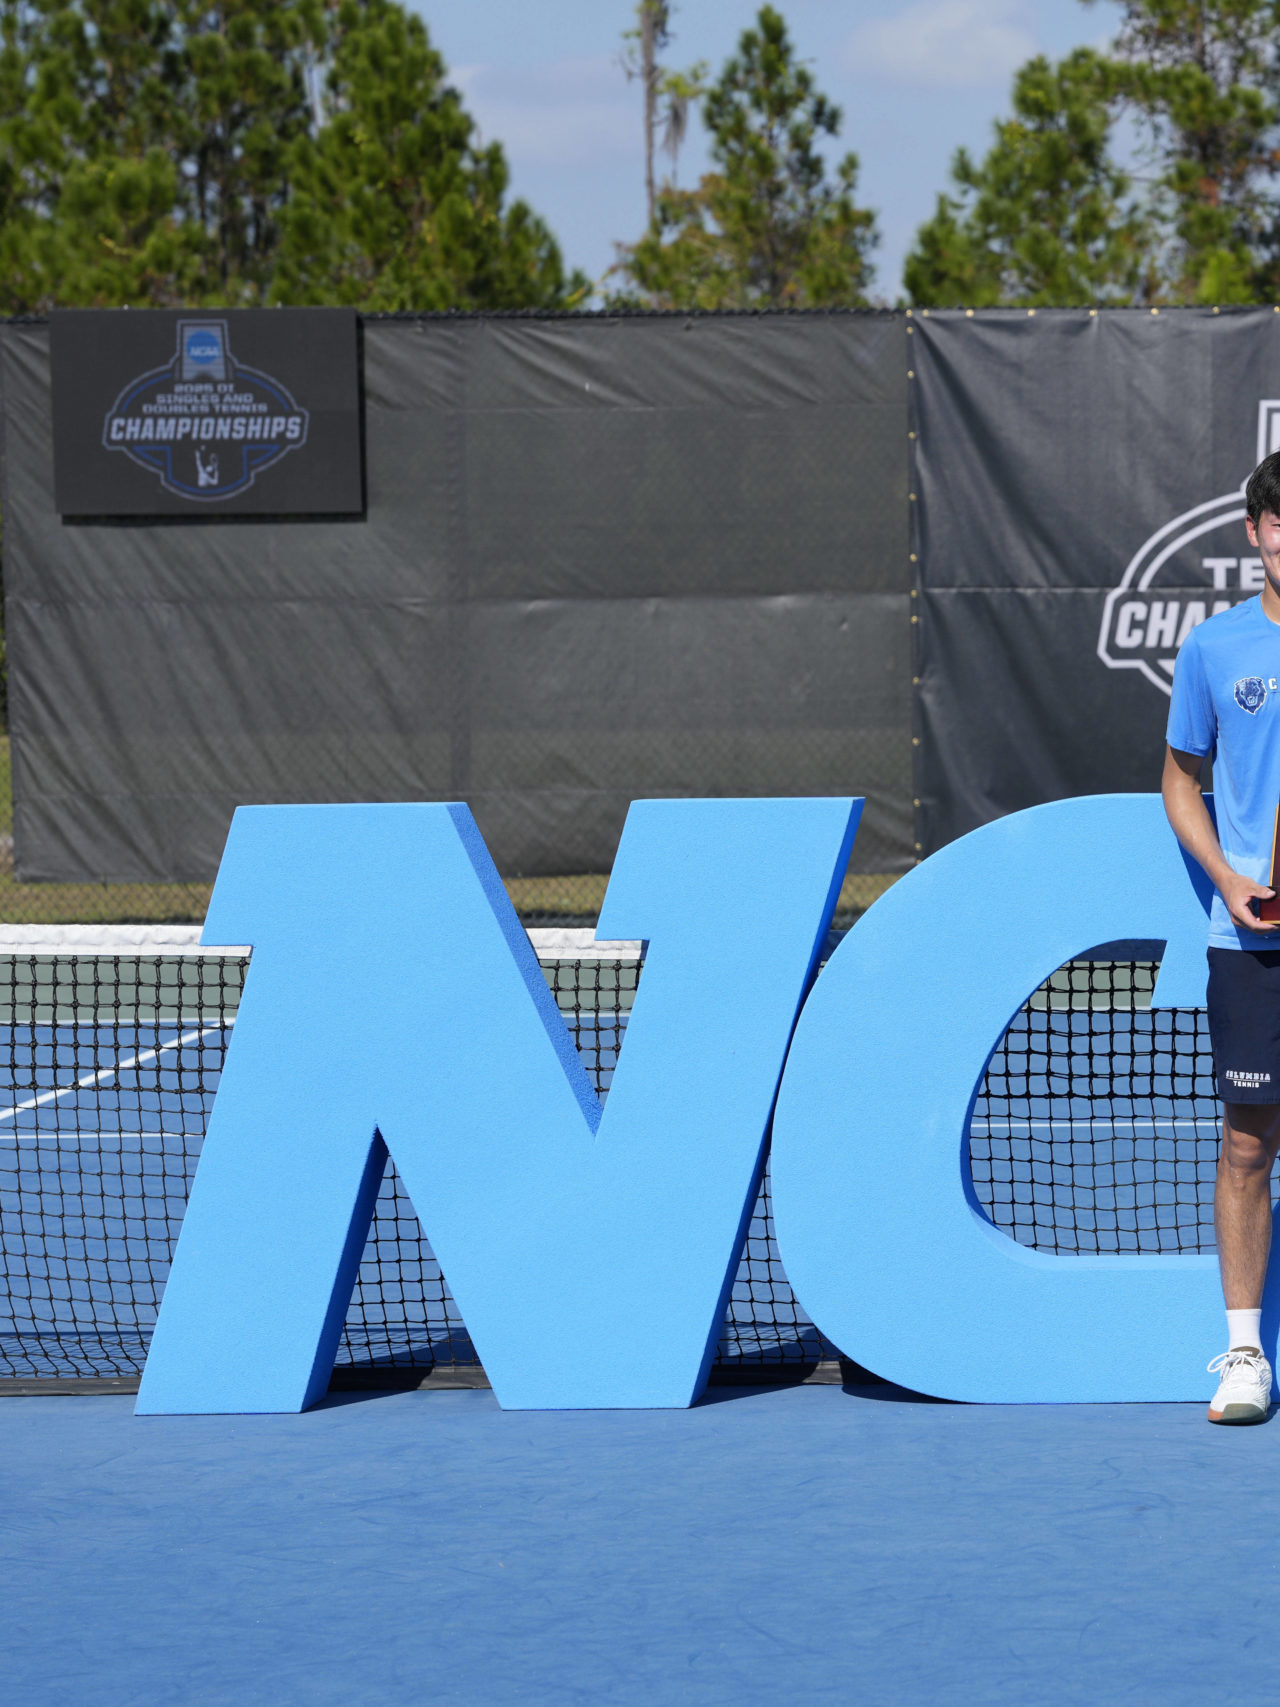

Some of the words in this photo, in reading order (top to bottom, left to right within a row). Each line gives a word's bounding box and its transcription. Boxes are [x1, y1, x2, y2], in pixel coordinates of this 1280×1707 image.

[189, 346, 219, 357] NCAA
[156, 393, 220, 404] SINGLES
[223, 393, 254, 404] AND
[142, 404, 210, 414] DOUBLES
[214, 402, 268, 413] TENNIS
[110, 416, 301, 441] CHAMPIONSHIPS
[1233, 1080, 1260, 1088] TENNIS
